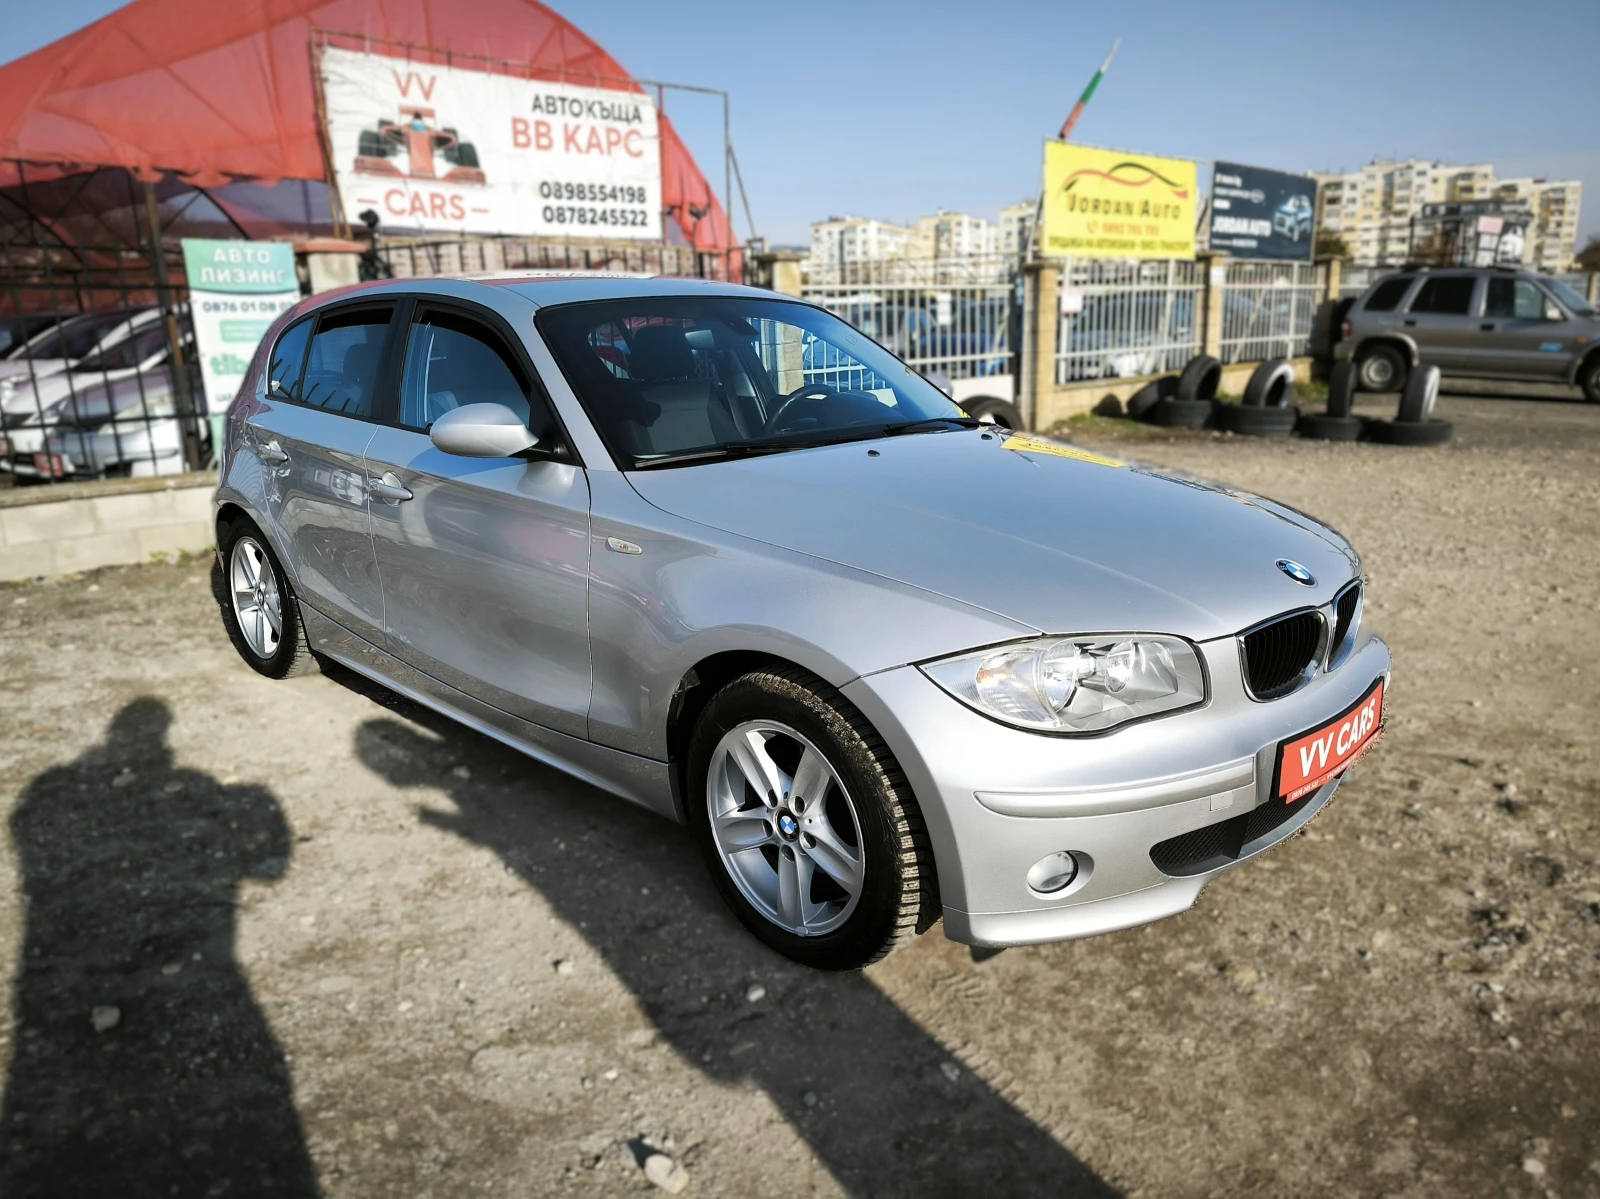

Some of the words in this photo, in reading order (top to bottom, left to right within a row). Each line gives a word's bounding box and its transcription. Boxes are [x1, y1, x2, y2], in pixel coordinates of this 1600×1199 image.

[392, 68, 437, 101] VV
[532, 94, 643, 125] АВТОКЪЩА
[563, 122, 644, 158] КАРС
[384, 188, 466, 220] CARS
[540, 181, 646, 204] 0898554198
[542, 205, 648, 227] 0878245522
[214, 248, 271, 264] АВТО
[201, 268, 286, 285] ЛИЗИНГ
[1300, 731, 1335, 778] VV
[1336, 697, 1376, 756] CARS
